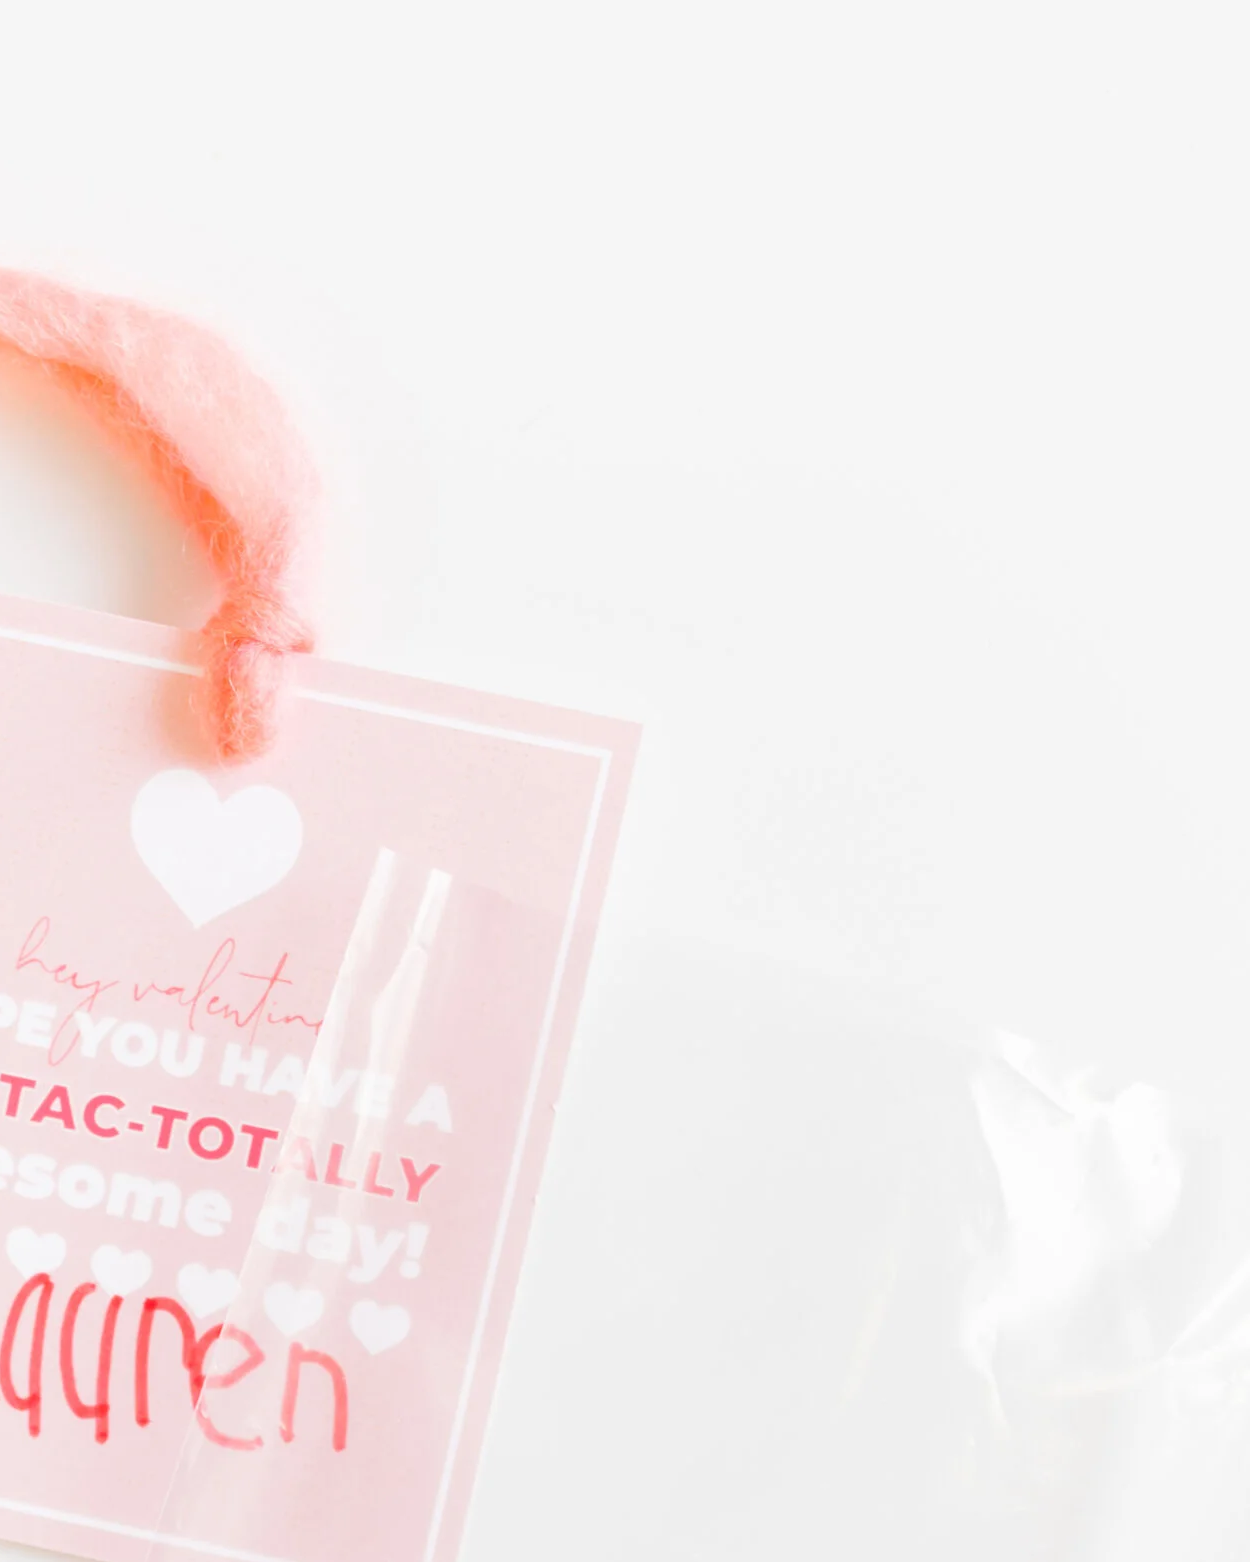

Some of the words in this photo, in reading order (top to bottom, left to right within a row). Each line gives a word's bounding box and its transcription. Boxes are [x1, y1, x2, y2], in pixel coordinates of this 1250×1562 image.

[15, 916, 117, 1065] hey
[71, 1009, 205, 1078] YOU
[218, 1042, 397, 1119] HAVE
[404, 1084, 454, 1134] A
[256, 1195, 433, 1283] day!
